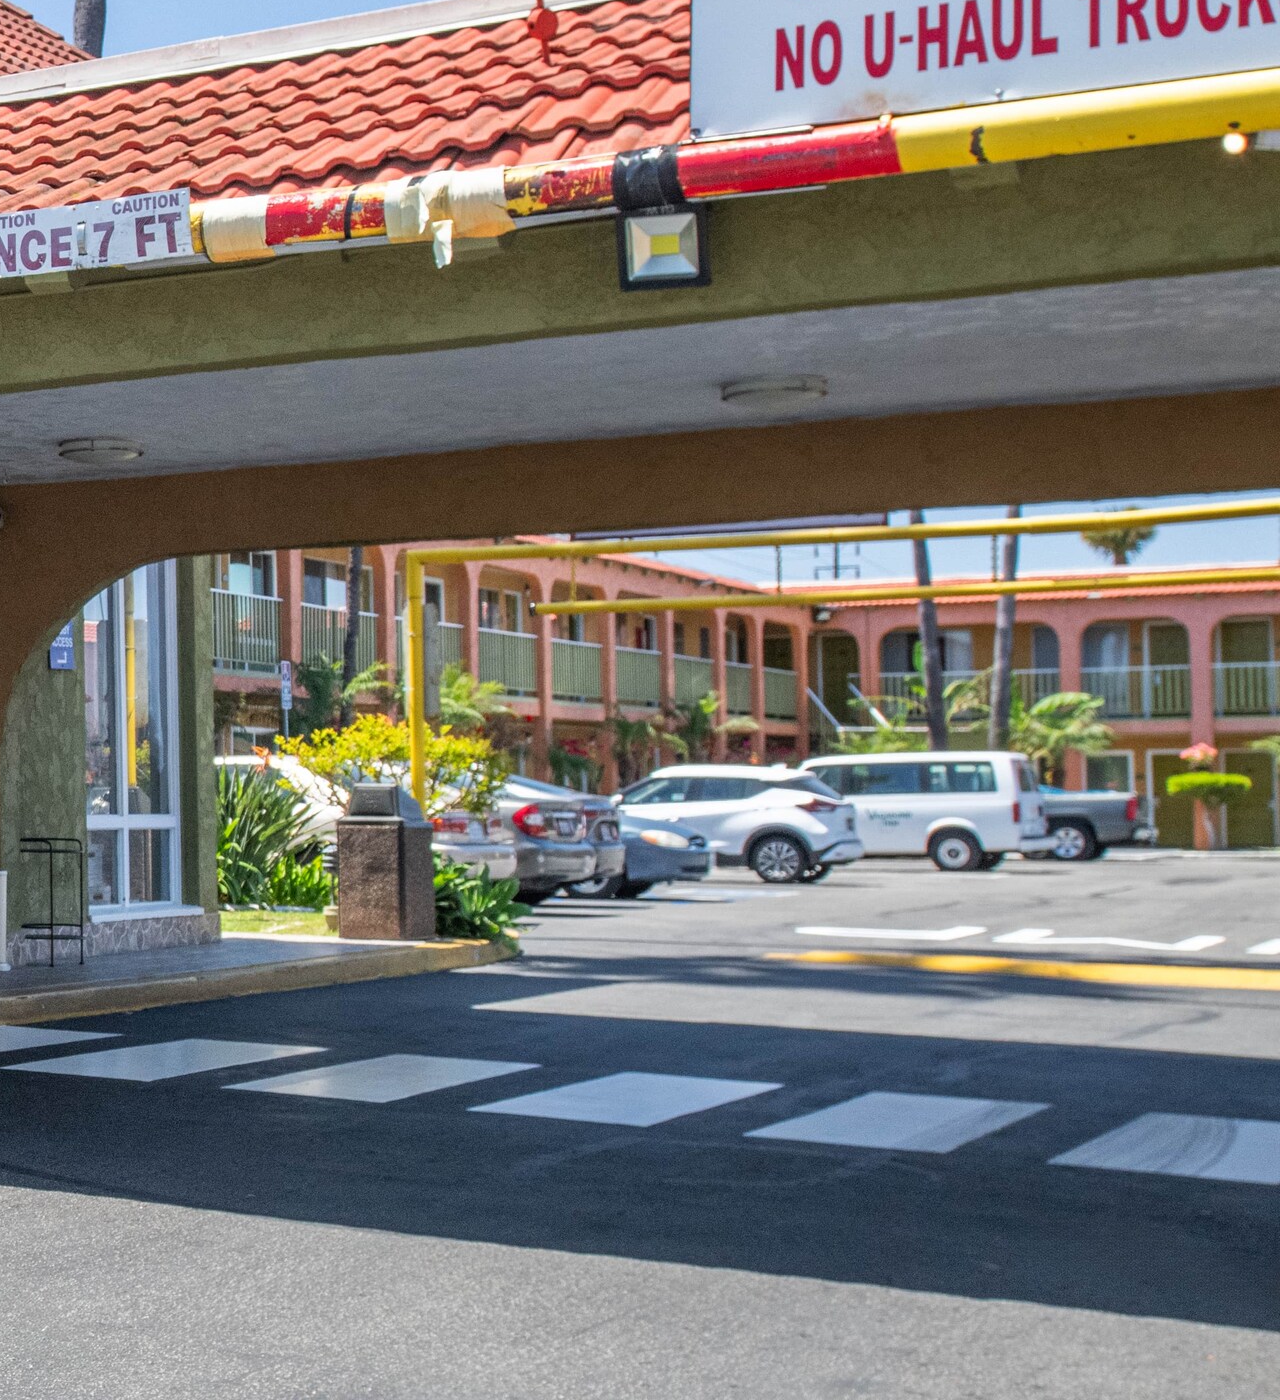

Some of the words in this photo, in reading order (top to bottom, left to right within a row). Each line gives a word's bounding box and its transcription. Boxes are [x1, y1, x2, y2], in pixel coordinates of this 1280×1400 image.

[774, 20, 842, 92] NO
[112, 193, 180, 215] CAUTION
[93, 221, 115, 263] 7
[134, 211, 182, 258] FT
